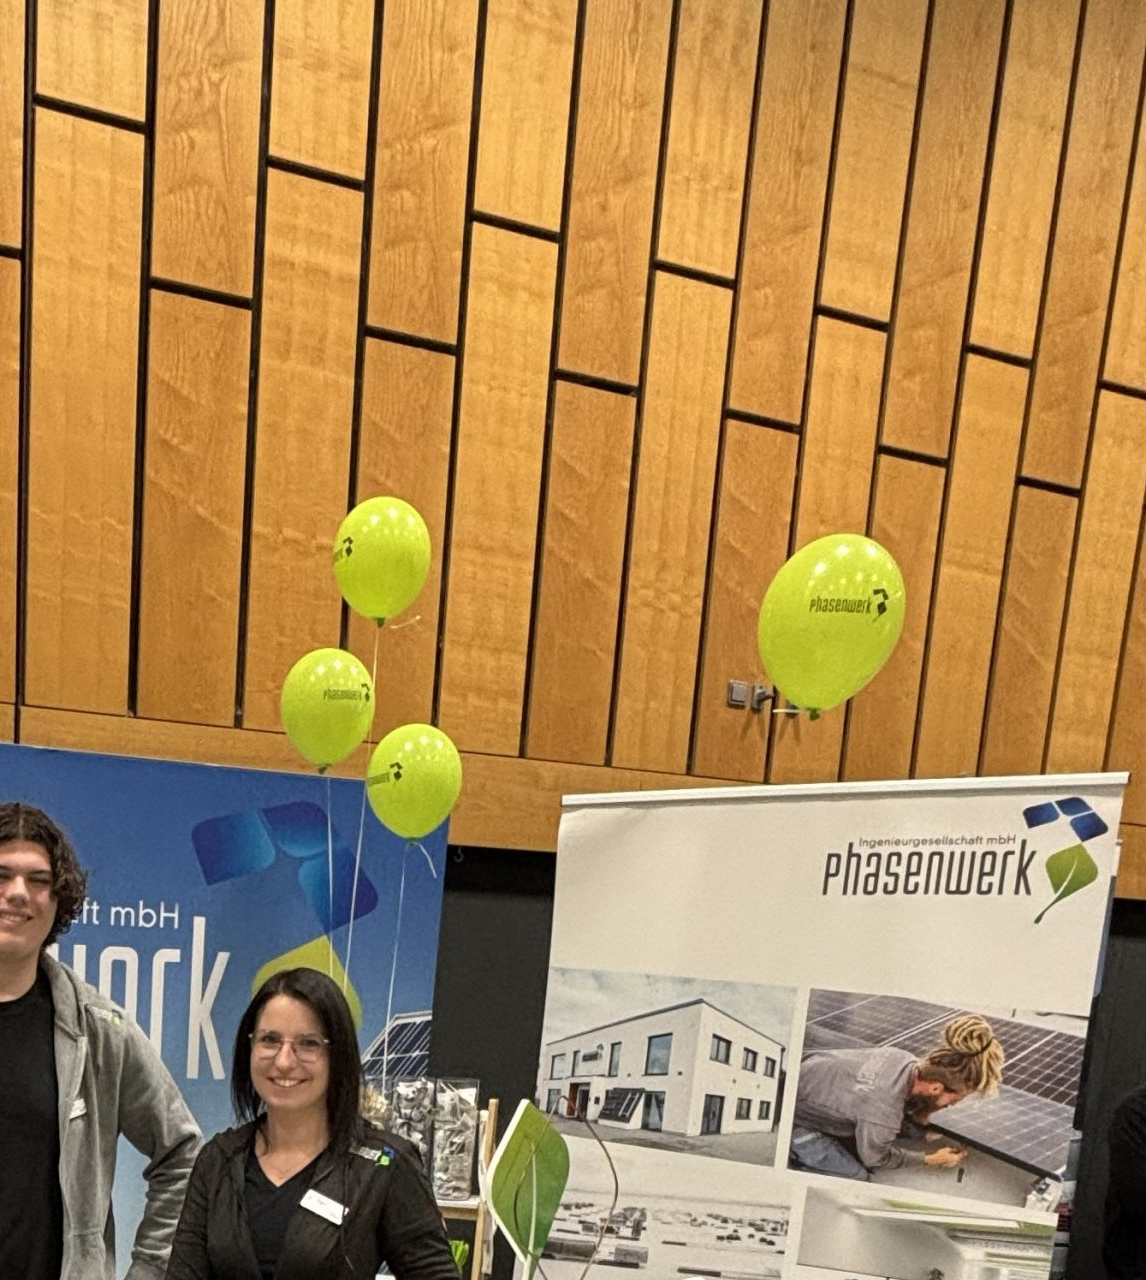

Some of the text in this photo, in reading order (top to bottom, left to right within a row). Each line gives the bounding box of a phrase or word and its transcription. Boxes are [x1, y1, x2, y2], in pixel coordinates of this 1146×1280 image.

[859, 834, 1017, 849] Ingenieurgesellschaft mbH
[822, 839, 1037, 896] phasenwerk
[110, 900, 179, 929] mbH
